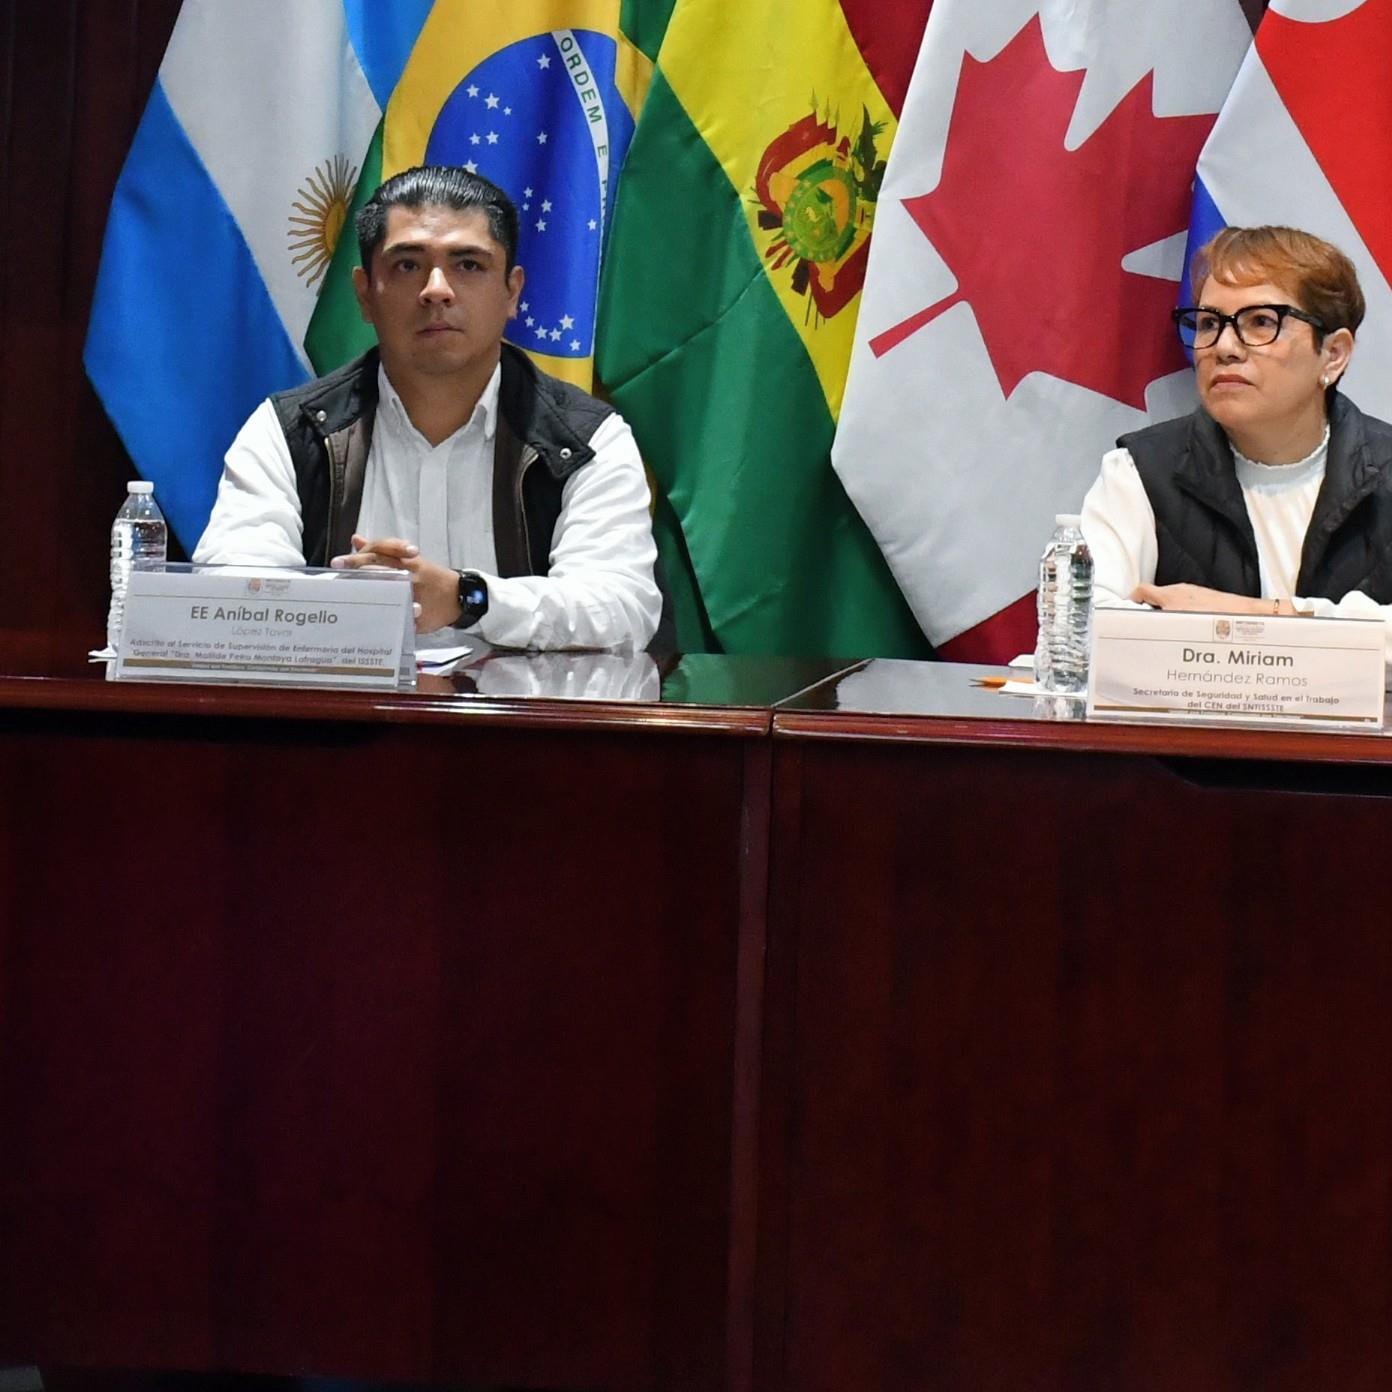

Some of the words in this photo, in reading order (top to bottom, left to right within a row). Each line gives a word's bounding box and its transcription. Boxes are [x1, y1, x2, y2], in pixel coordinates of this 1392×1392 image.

[560, 36, 603, 123] ORDEM
[597, 145, 608, 157] E
[191, 606, 209, 619] EE
[214, 605, 269, 621] Aníbal
[275, 608, 338, 626] Rogelio
[214, 641, 225, 649] de
[279, 643, 290, 651] de
[1183, 648, 1221, 664] Dra.
[1228, 650, 1294, 667] Miriam
[1167, 669, 1251, 685] Hernández
[1256, 673, 1308, 687] Ramos
[1182, 690, 1193, 698] de
[1196, 691, 1242, 700] Seguridad
[1253, 693, 1278, 701] Salud
